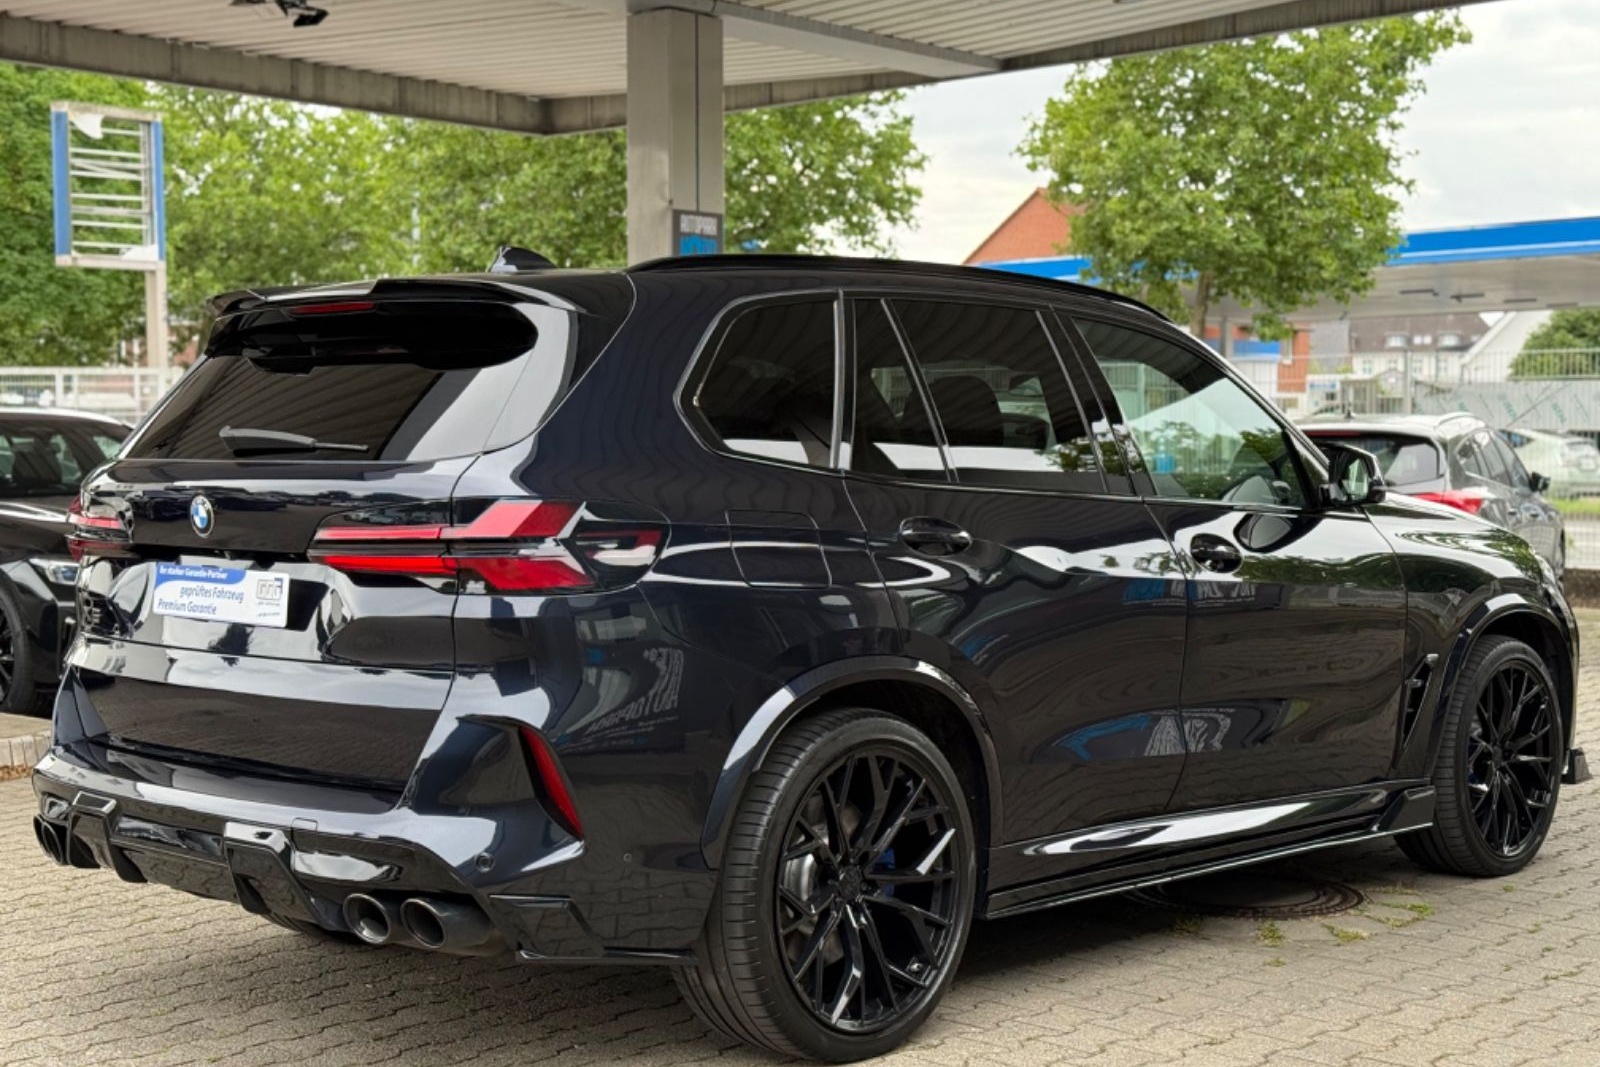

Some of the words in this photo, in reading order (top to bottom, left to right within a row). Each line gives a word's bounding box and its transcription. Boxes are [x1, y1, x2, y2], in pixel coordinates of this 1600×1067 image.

[180, 584, 212, 599] geprüftes
[213, 586, 245, 604] Fahrzeug
[157, 598, 187, 612] Premium
[187, 600, 217, 615] Garantie
